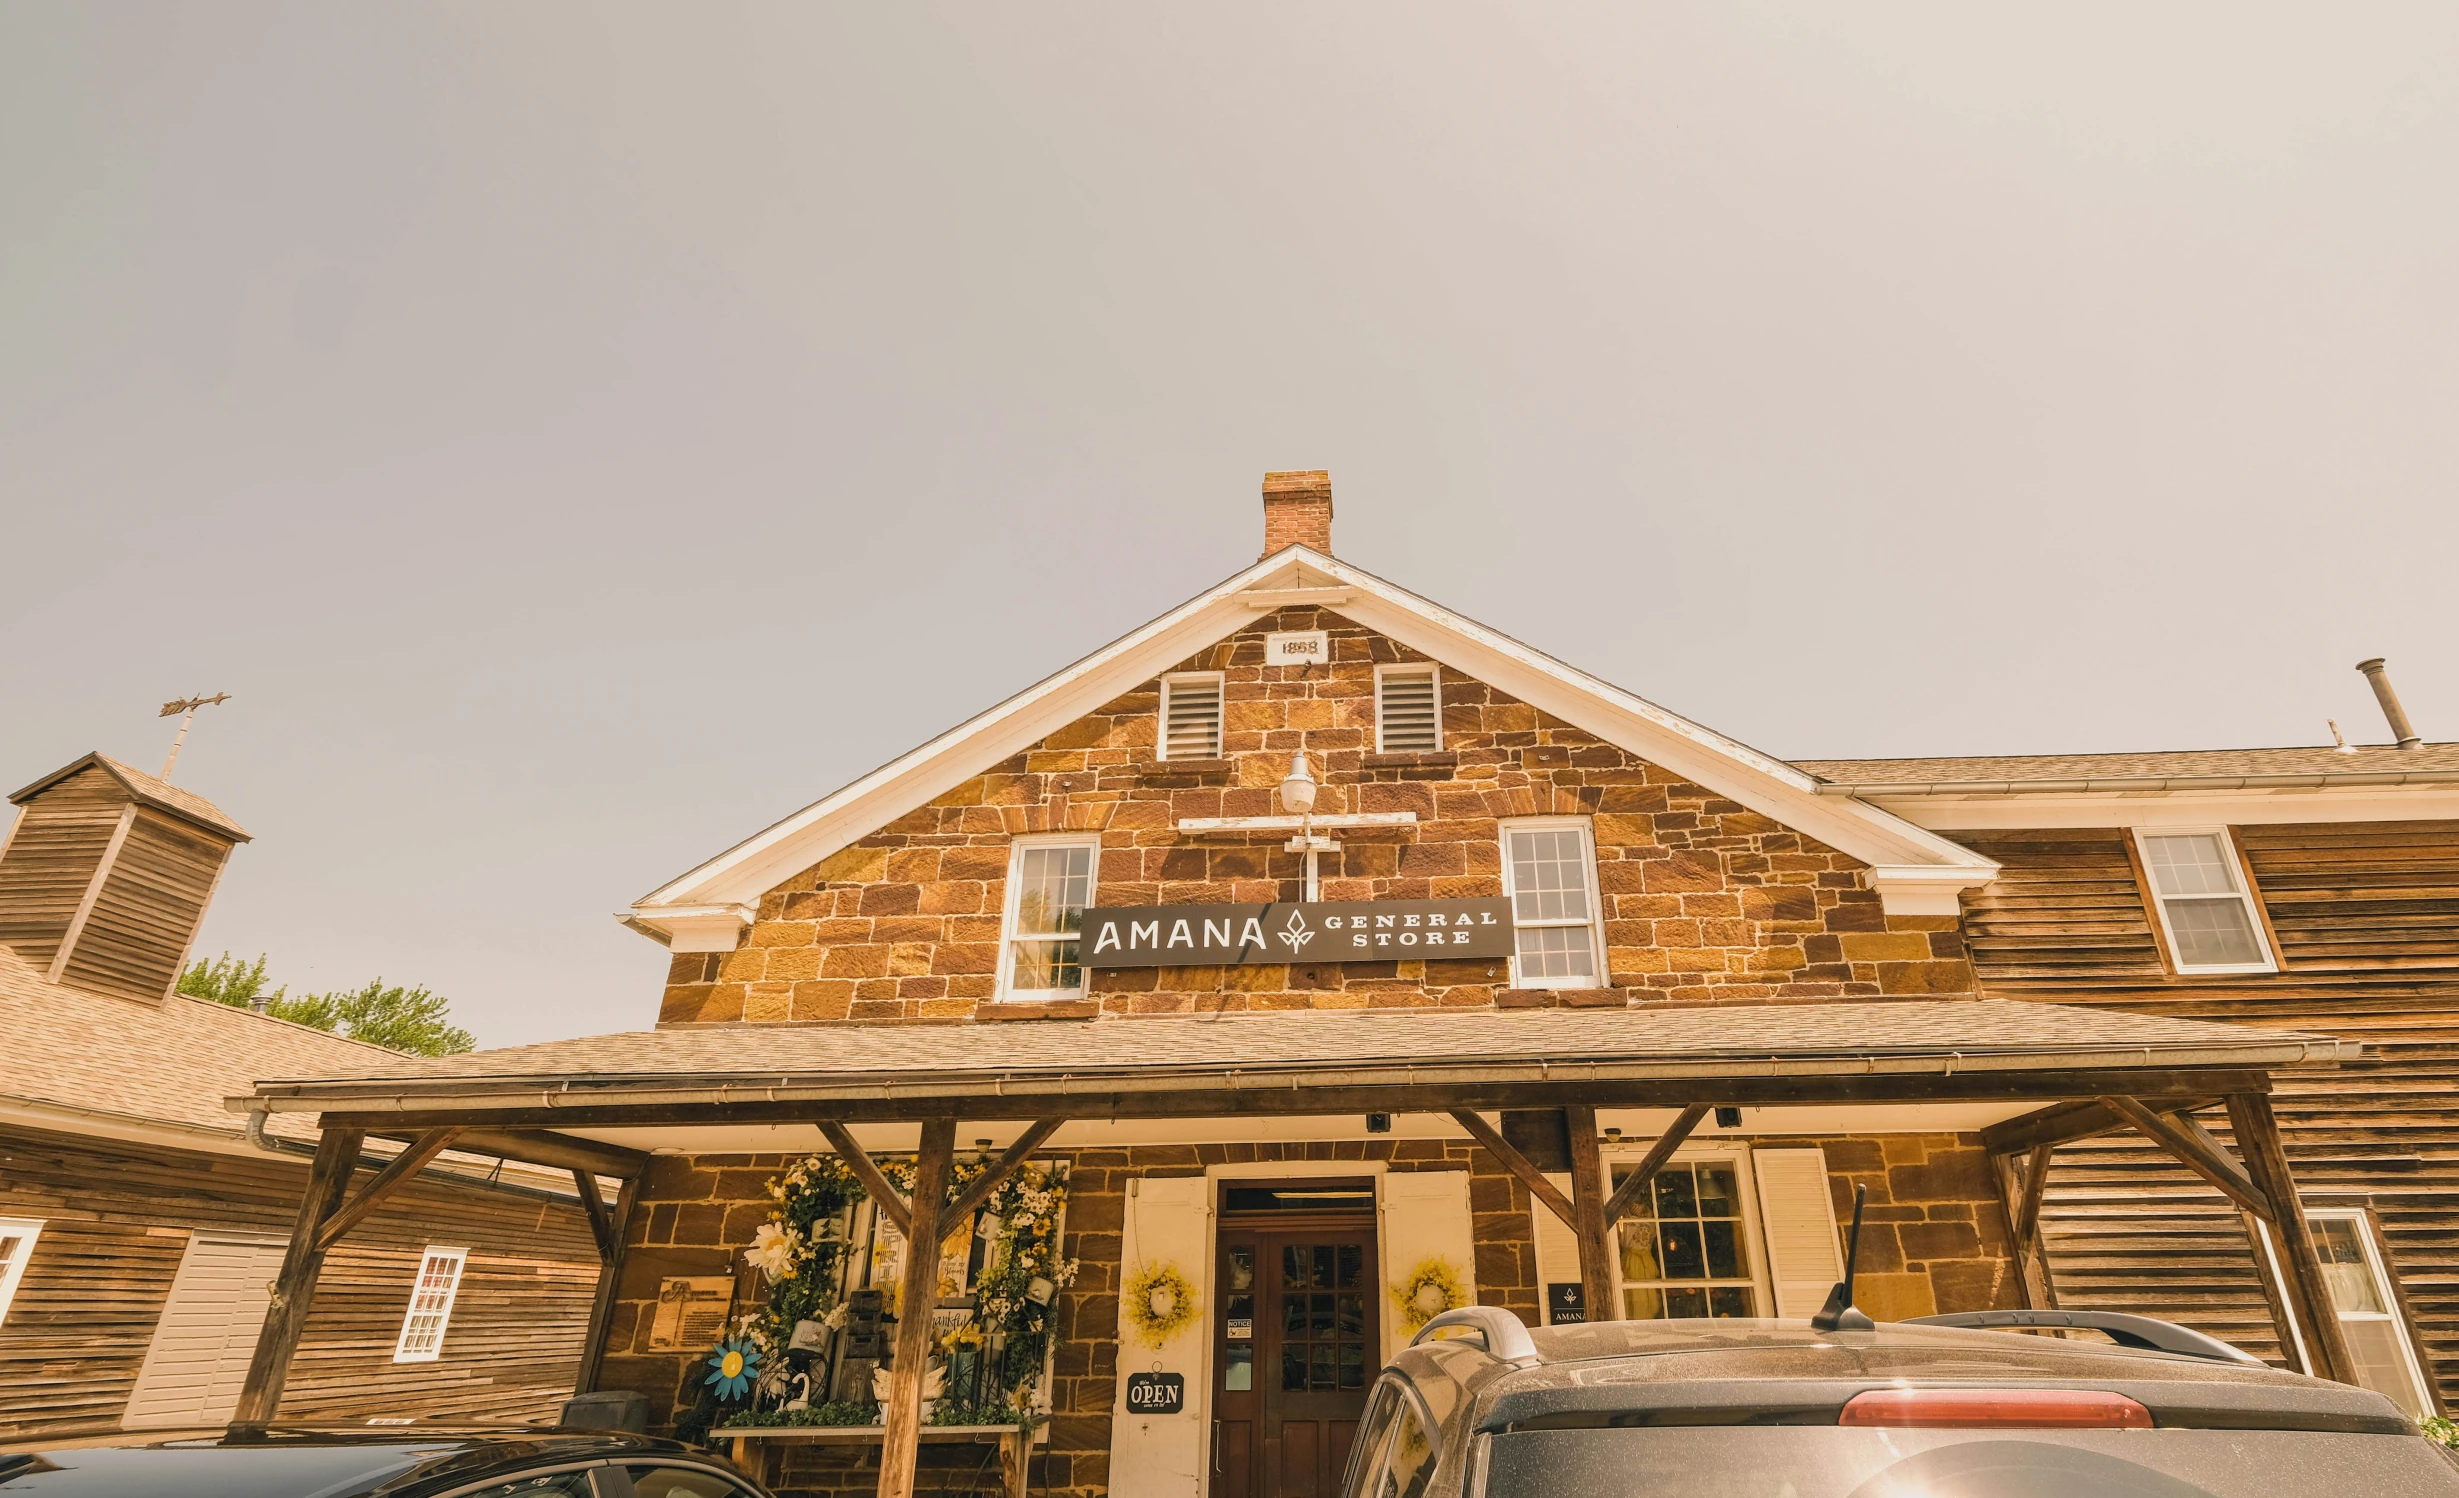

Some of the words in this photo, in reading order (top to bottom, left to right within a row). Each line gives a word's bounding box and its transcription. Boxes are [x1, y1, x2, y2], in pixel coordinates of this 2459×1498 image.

[1325, 912, 1497, 929] GENERAL
[1094, 917, 1267, 954] AMANA
[1352, 931, 1470, 947] STORE
[1131, 1385, 1179, 1404] OPEN
